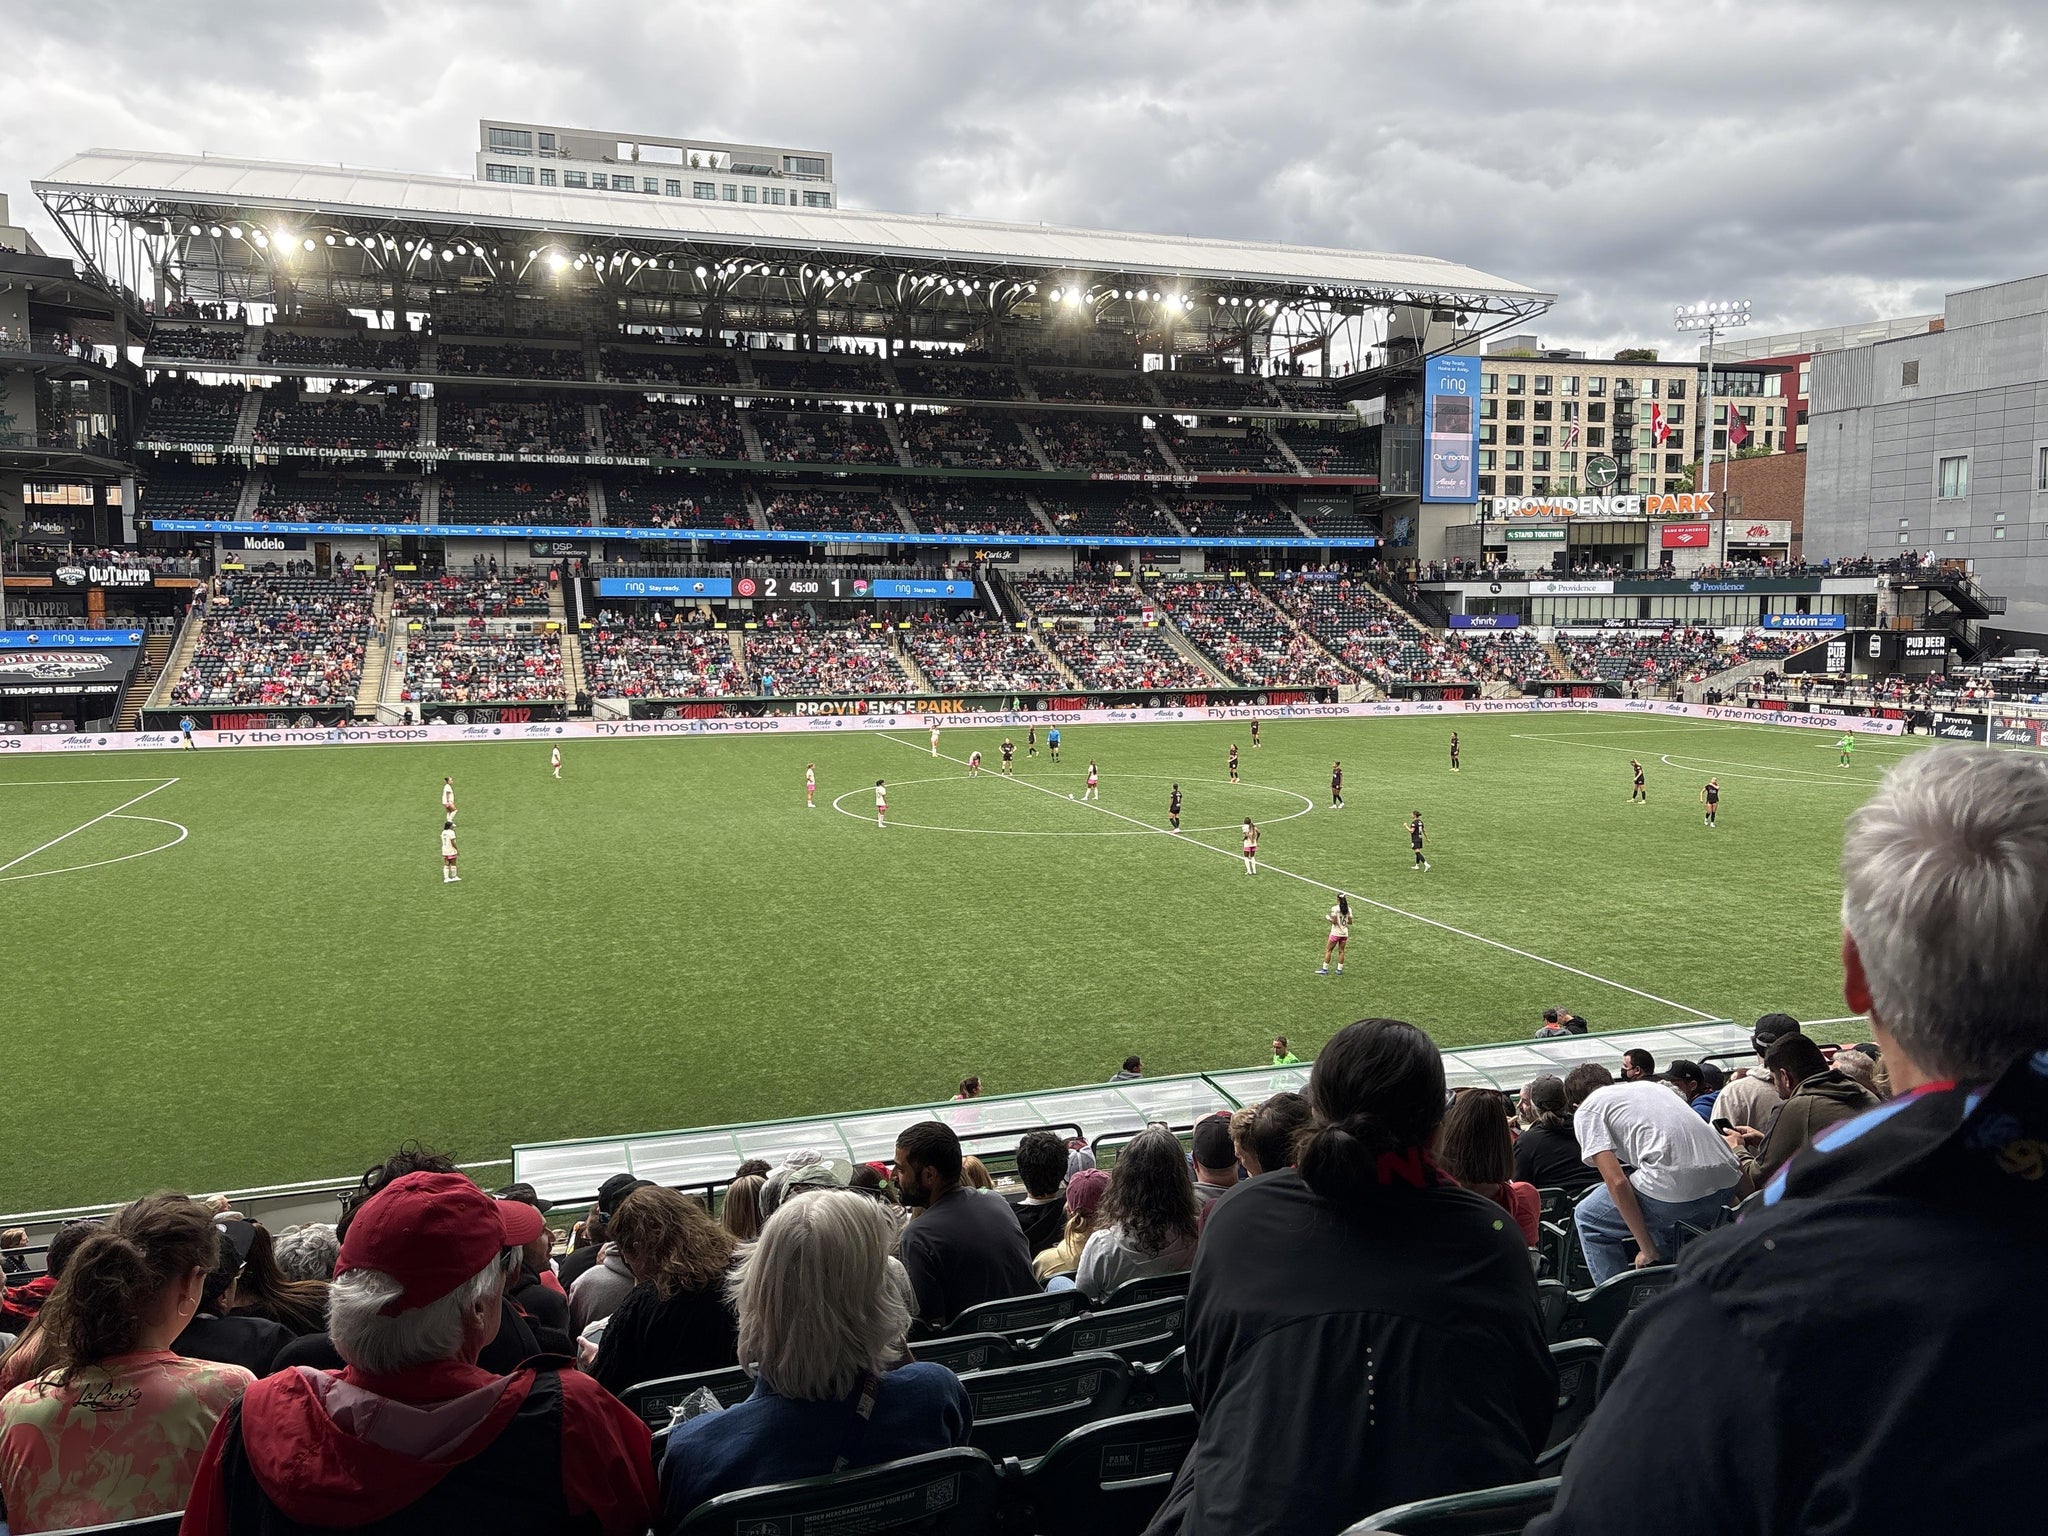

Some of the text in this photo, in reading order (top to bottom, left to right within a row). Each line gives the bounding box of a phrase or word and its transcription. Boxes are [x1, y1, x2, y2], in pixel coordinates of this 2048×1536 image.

[1440, 375, 1466, 394] ring
[148, 442, 171, 451] RING
[180, 443, 214, 452] HONOR
[222, 444, 280, 455] JOHN BAIN
[286, 446, 368, 458] CLIVE CHARLES
[375, 450, 450, 460] JIMMY CONWAY
[458, 452, 514, 462] TIMBER JIM
[520, 454, 579, 464] MICK HOBAN
[585, 456, 650, 466] DIEGO VALERI
[1492, 492, 1715, 516] PROVIDENCE PARK
[244, 536, 285, 550] Modelo
[552, 542, 572, 550] DSP
[626, 582, 645, 593] ring
[764, 578, 840, 597] 2 45:00 1
[895, 584, 910, 595] ring
[1703, 583, 1744, 591] Providence
[1470, 616, 1497, 626] xfinity
[1604, 619, 1625, 627] Ford
[1783, 616, 1817, 626] axiom
[53, 634, 74, 644] ring
[1906, 636, 1945, 648] PUB BEER
[1827, 647, 1846, 658] PUB
[1827, 658, 1845, 667] BEER
[1268, 692, 1304, 704] THORNS
[1443, 688, 1464, 700] 2012
[917, 700, 965, 713] PARK
[1208, 705, 1350, 718] Fly the most non-stops
[1465, 700, 1598, 712] Fly the most non-stops
[500, 708, 532, 723] 2012
[924, 713, 1080, 726] Fly the most non-stops
[1706, 707, 1837, 727] Fly the most non-stops
[596, 720, 778, 734] Fly the most non-stops
[1941, 725, 1974, 737] Alaska
[62, 735, 92, 744] Alaska
[134, 734, 165, 743] Alaska
[218, 728, 427, 744] Fly the most non-stops
[1997, 730, 2031, 742] Alaska
[1110, 1455, 1130, 1463] PARK
[804, 1492, 915, 1523] ORDER MERCHANDISE FROM YOUR SEAT
